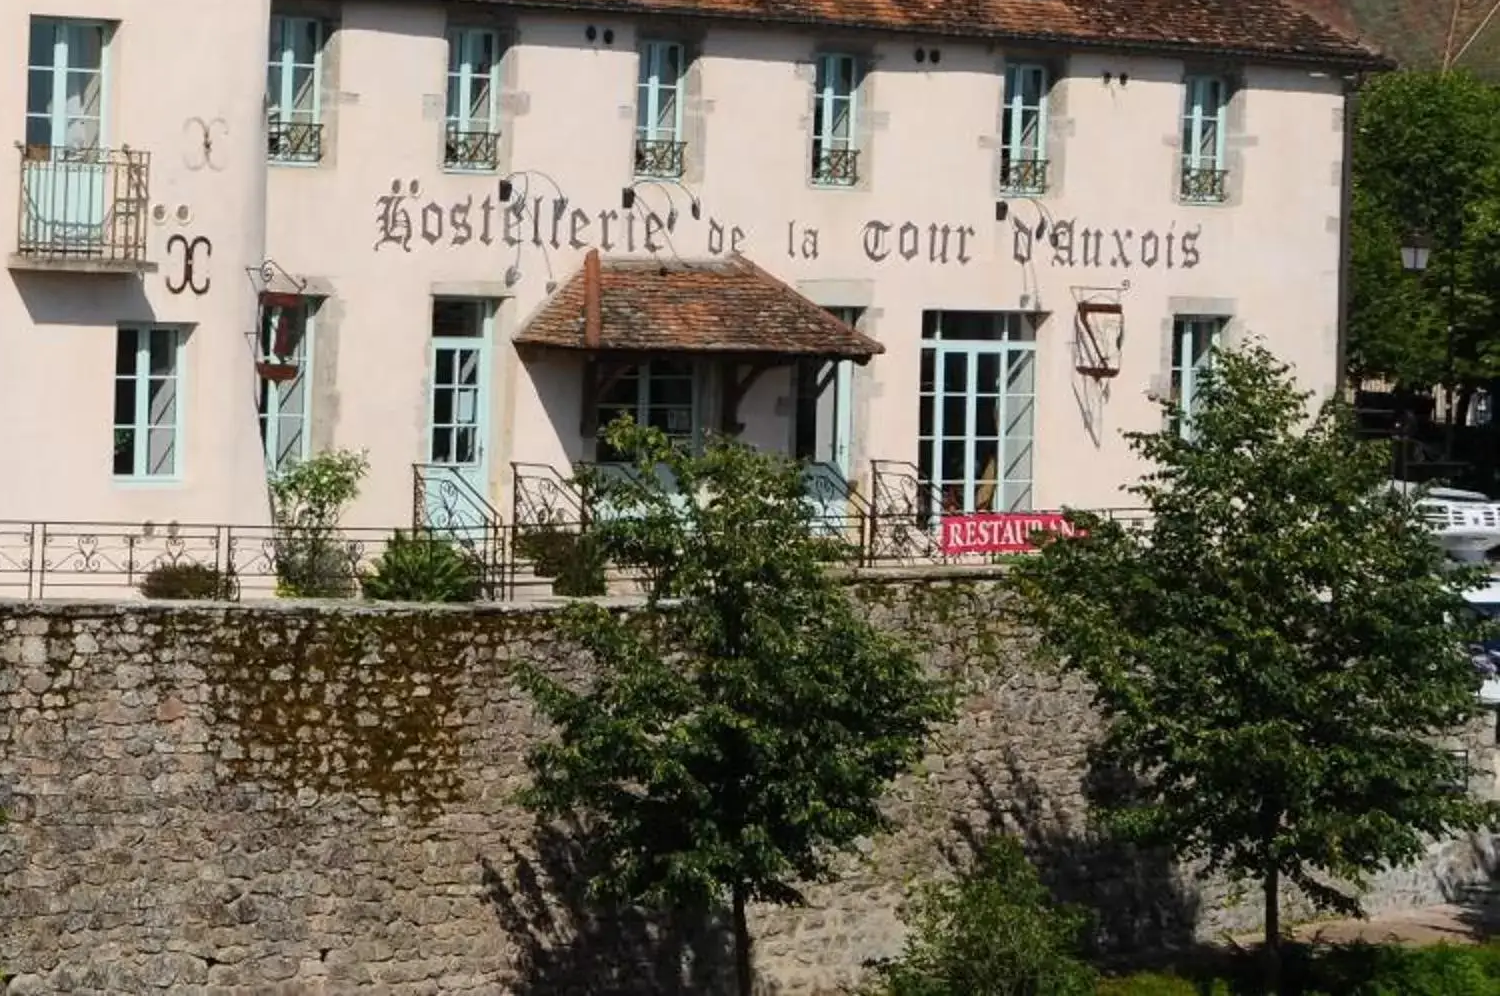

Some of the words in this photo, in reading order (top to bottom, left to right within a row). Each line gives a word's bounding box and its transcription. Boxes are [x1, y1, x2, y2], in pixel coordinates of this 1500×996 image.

[373, 194, 664, 253] Hostellerie
[707, 217, 747, 255] de
[787, 219, 820, 260] la
[862, 220, 976, 265] Tour
[948, 518, 1088, 547] RESTAUN
